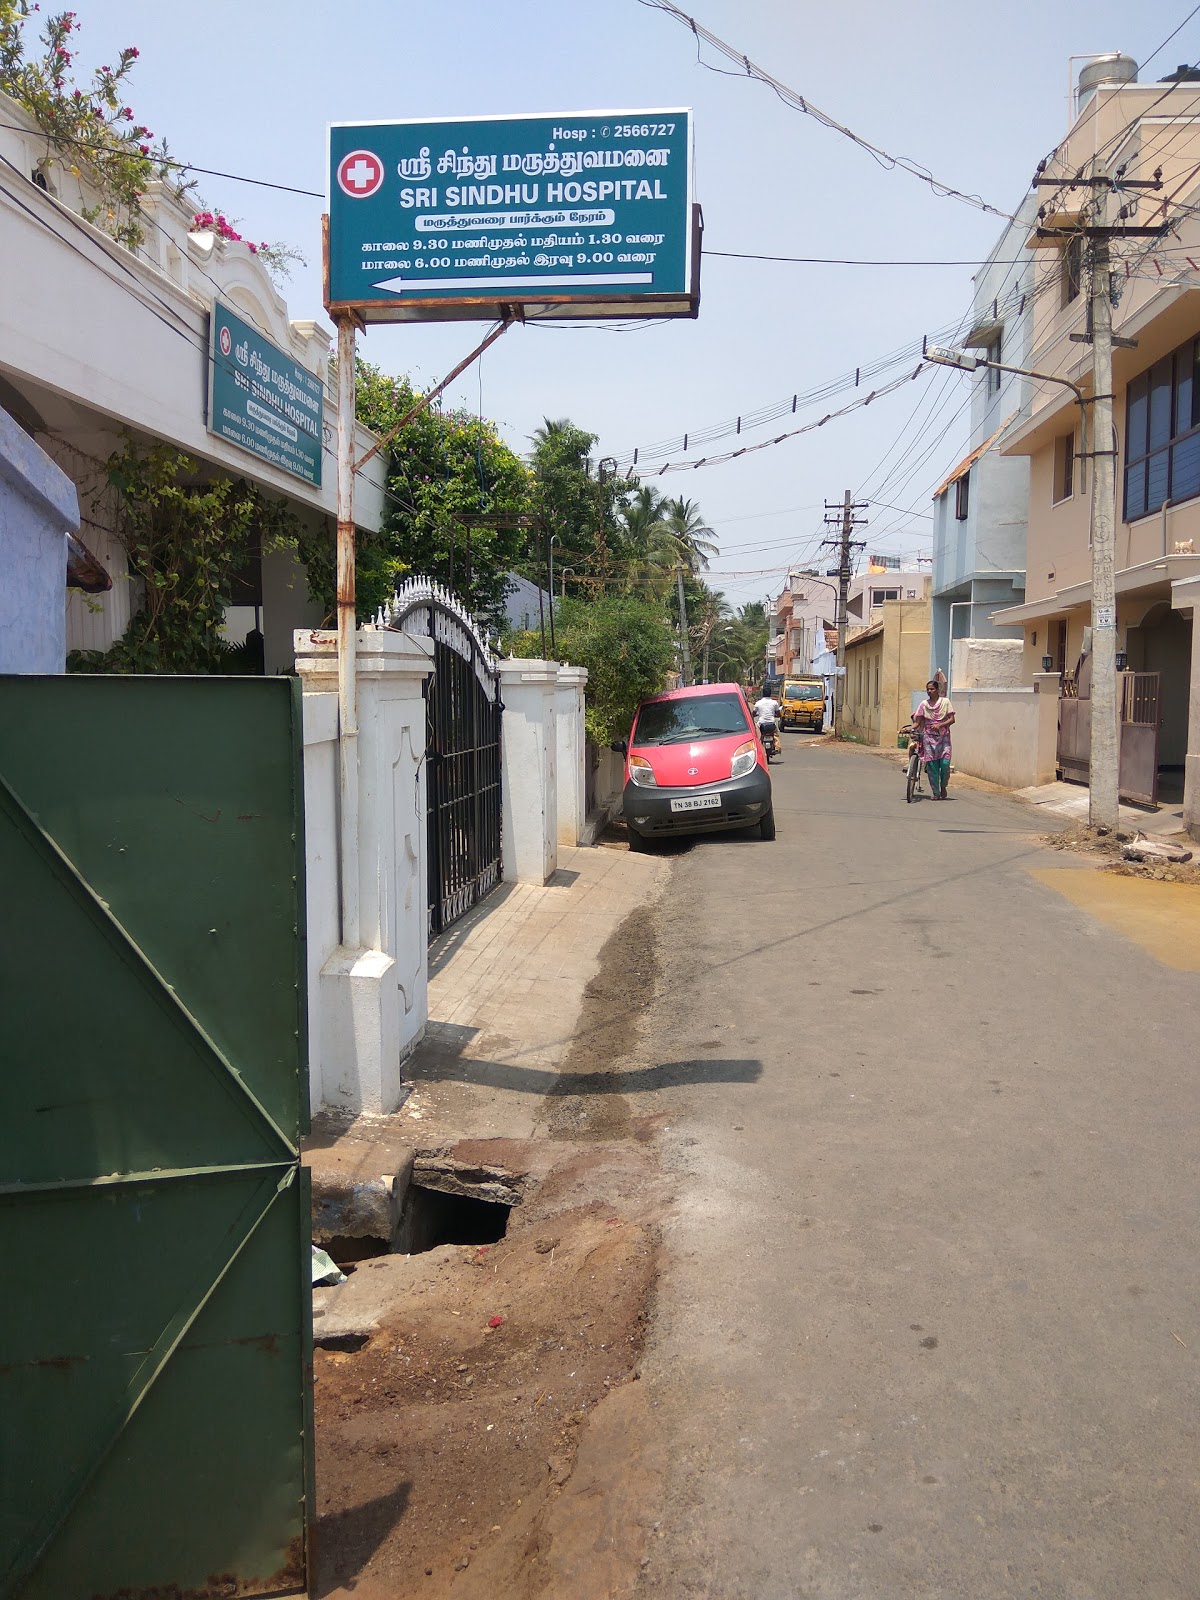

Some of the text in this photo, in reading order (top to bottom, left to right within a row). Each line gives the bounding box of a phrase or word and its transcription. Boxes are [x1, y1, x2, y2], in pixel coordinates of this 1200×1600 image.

[552, 127, 588, 141] Hosp
[614, 123, 676, 137] 2566727
[436, 146, 497, 180] சிந்து
[502, 142, 671, 177] மருத்துவமனை
[400, 179, 668, 208] SRI SINDHU HOSPITAL
[423, 210, 606, 229] மருத்துவரை பார்க்கும் நேரம்
[361, 232, 665, 252] காலை 9.30 மணிமுதல் மதியம் 1.30 வரை
[361, 251, 657, 270] மாலை 6.00 மணிமுதல் இரவு 9.00 வரை
[241, 417, 255, 432] 9.30
[284, 401, 319, 437] HOSPITAL
[241, 434, 255, 448] 6.00
[674, 801, 683, 809] TN
[703, 798, 719, 806] 2162
